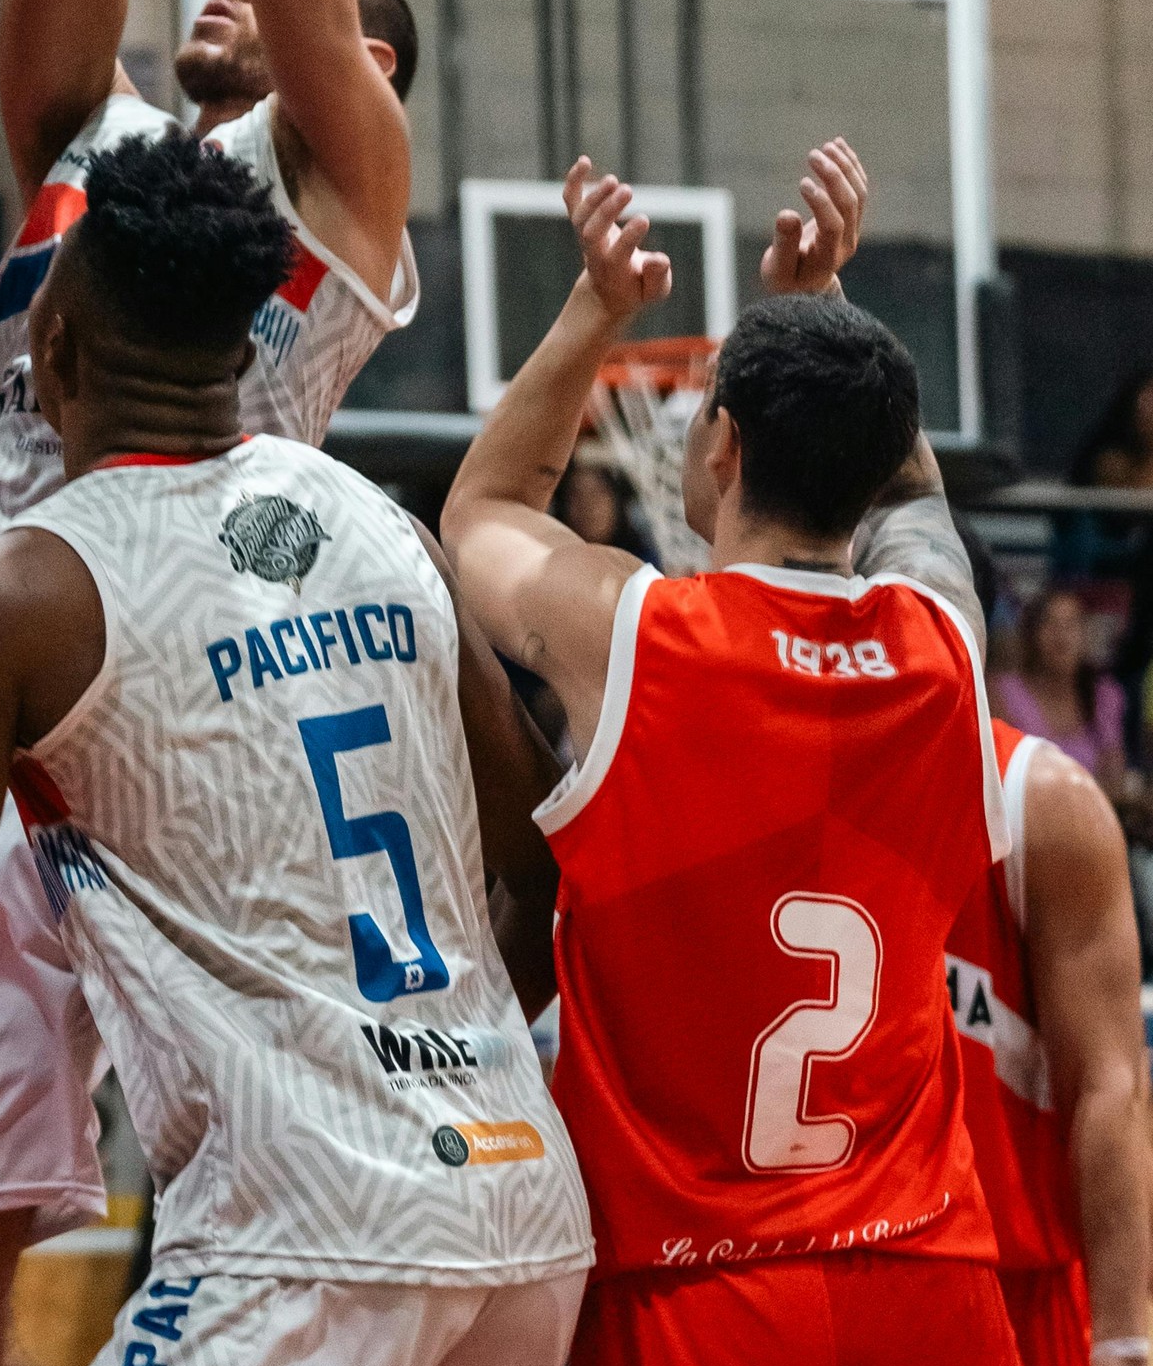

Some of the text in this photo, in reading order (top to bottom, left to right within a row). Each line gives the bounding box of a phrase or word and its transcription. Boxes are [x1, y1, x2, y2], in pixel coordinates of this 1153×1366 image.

[206, 602, 417, 702] PACIFICO
[297, 704, 450, 1004] 5
[743, 891, 883, 1174] 2
